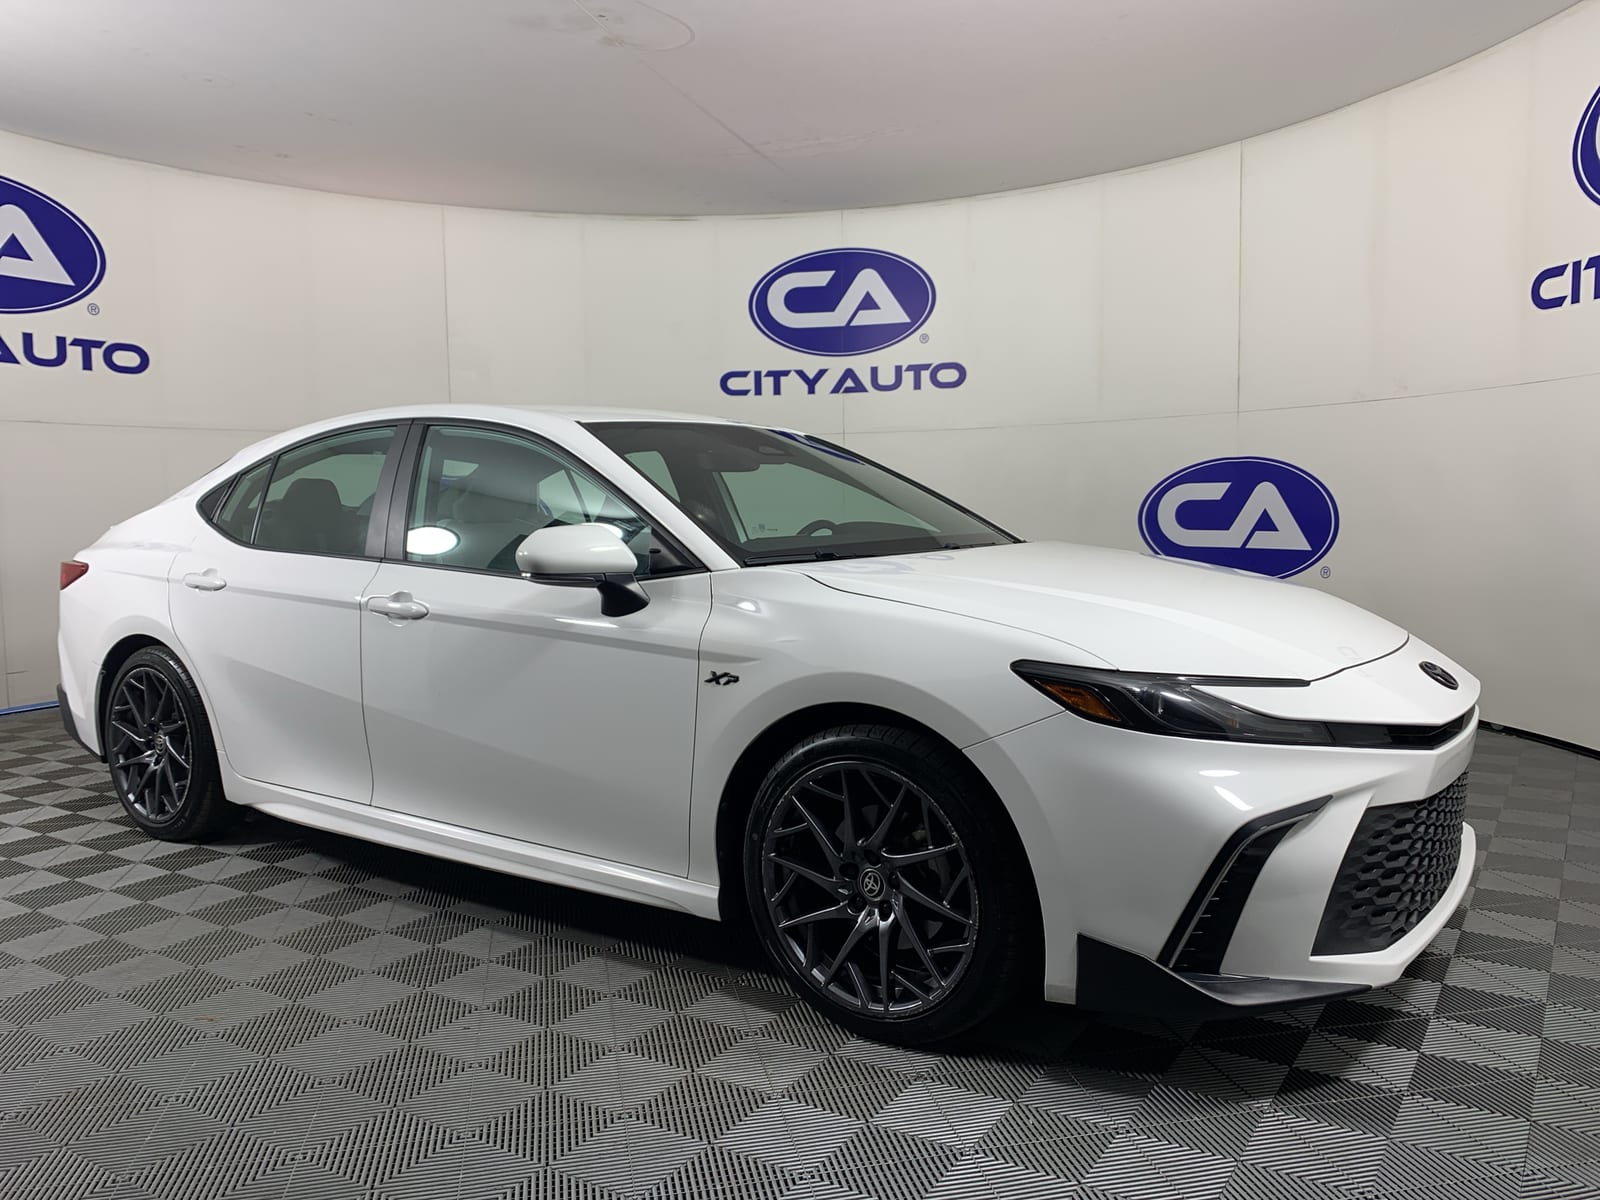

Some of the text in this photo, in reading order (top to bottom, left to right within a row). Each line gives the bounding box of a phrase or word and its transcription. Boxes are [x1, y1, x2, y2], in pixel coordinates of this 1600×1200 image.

[766, 268, 912, 328] CA
[719, 361, 967, 396] CITY AUTO
[1157, 481, 1313, 551] CA
